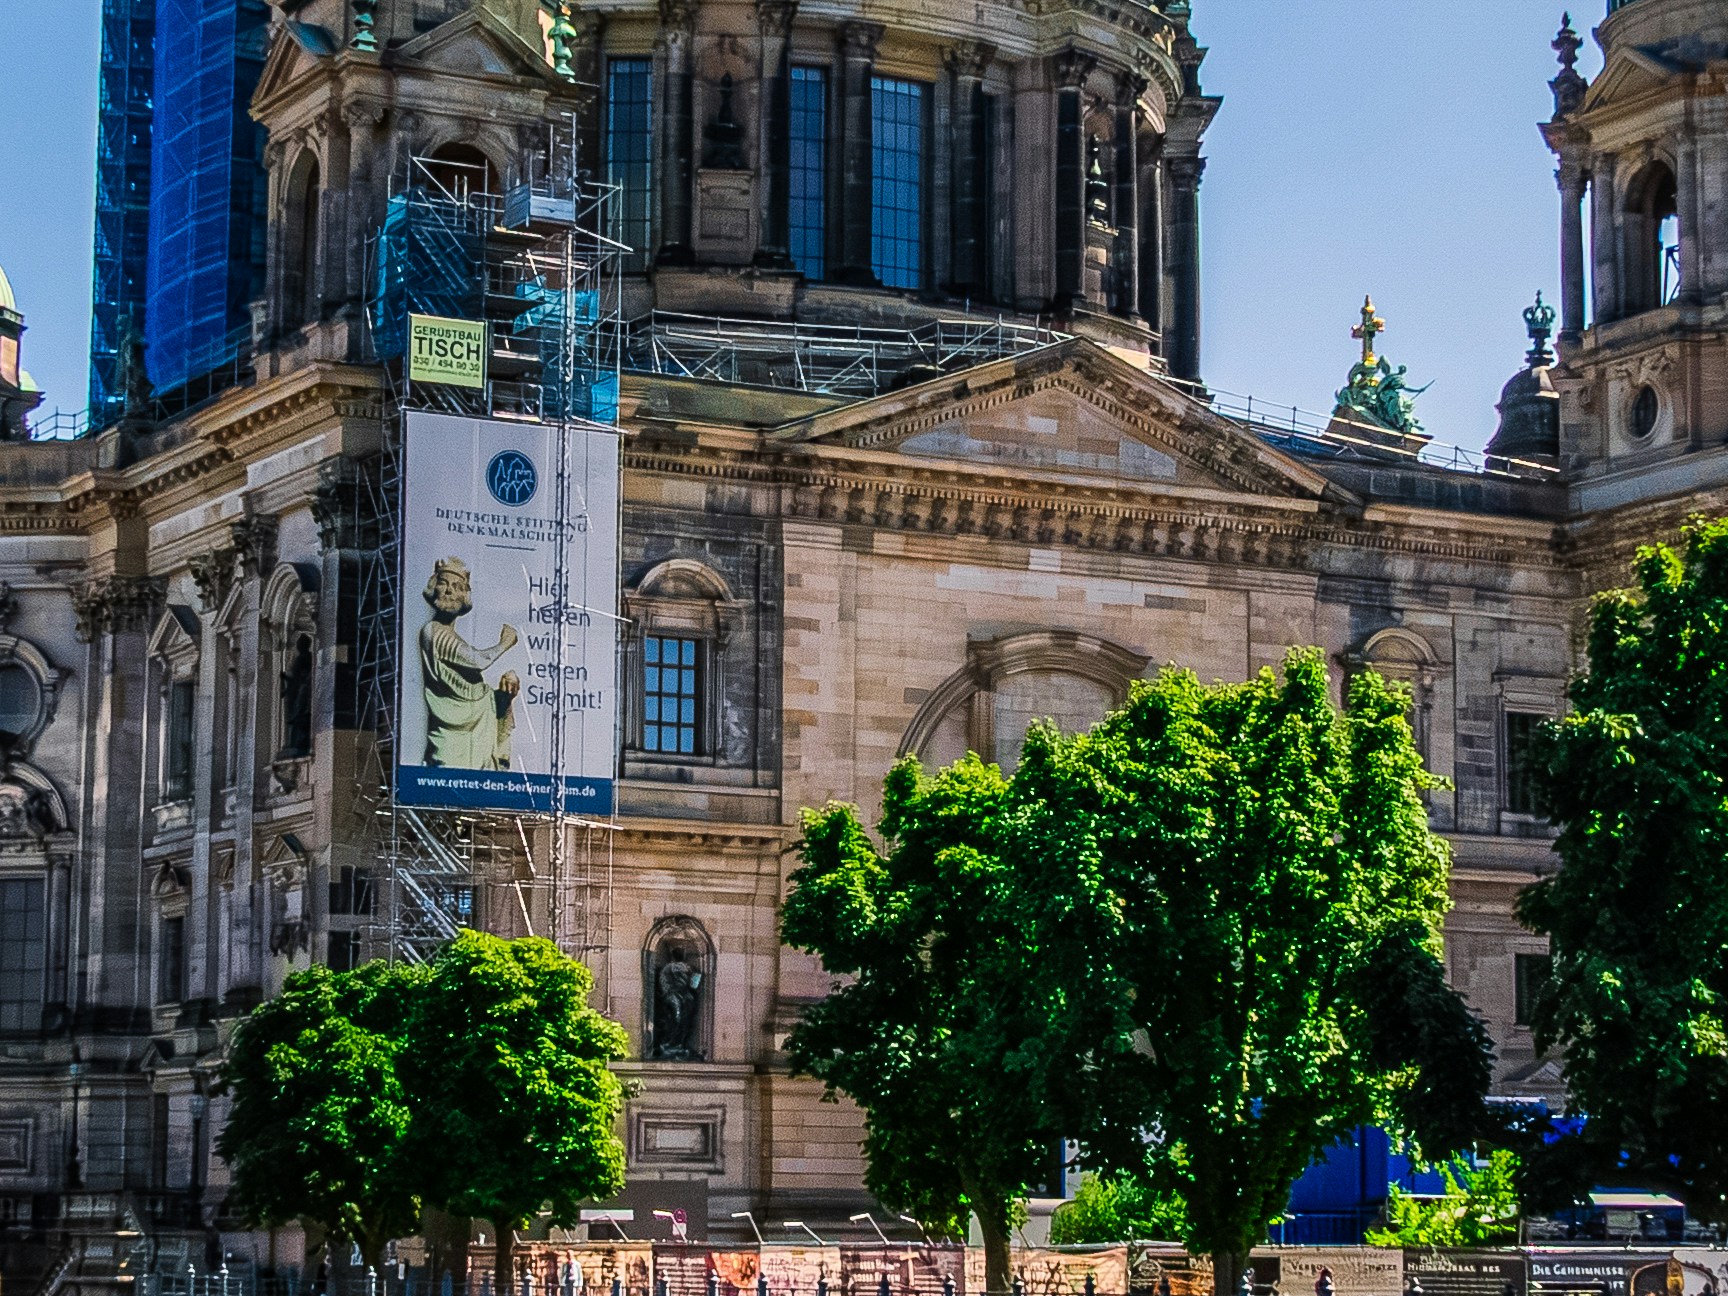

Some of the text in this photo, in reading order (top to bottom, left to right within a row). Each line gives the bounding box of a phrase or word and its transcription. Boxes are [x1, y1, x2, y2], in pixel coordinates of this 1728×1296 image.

[414, 325, 481, 342] GERÜSTBAU
[413, 335, 481, 362] TISCH
[436, 507, 588, 533] DEUTSCHE STIFTNG
[447, 522, 575, 544] DENKMALSCHUZ
[527, 684, 557, 706] Sie
